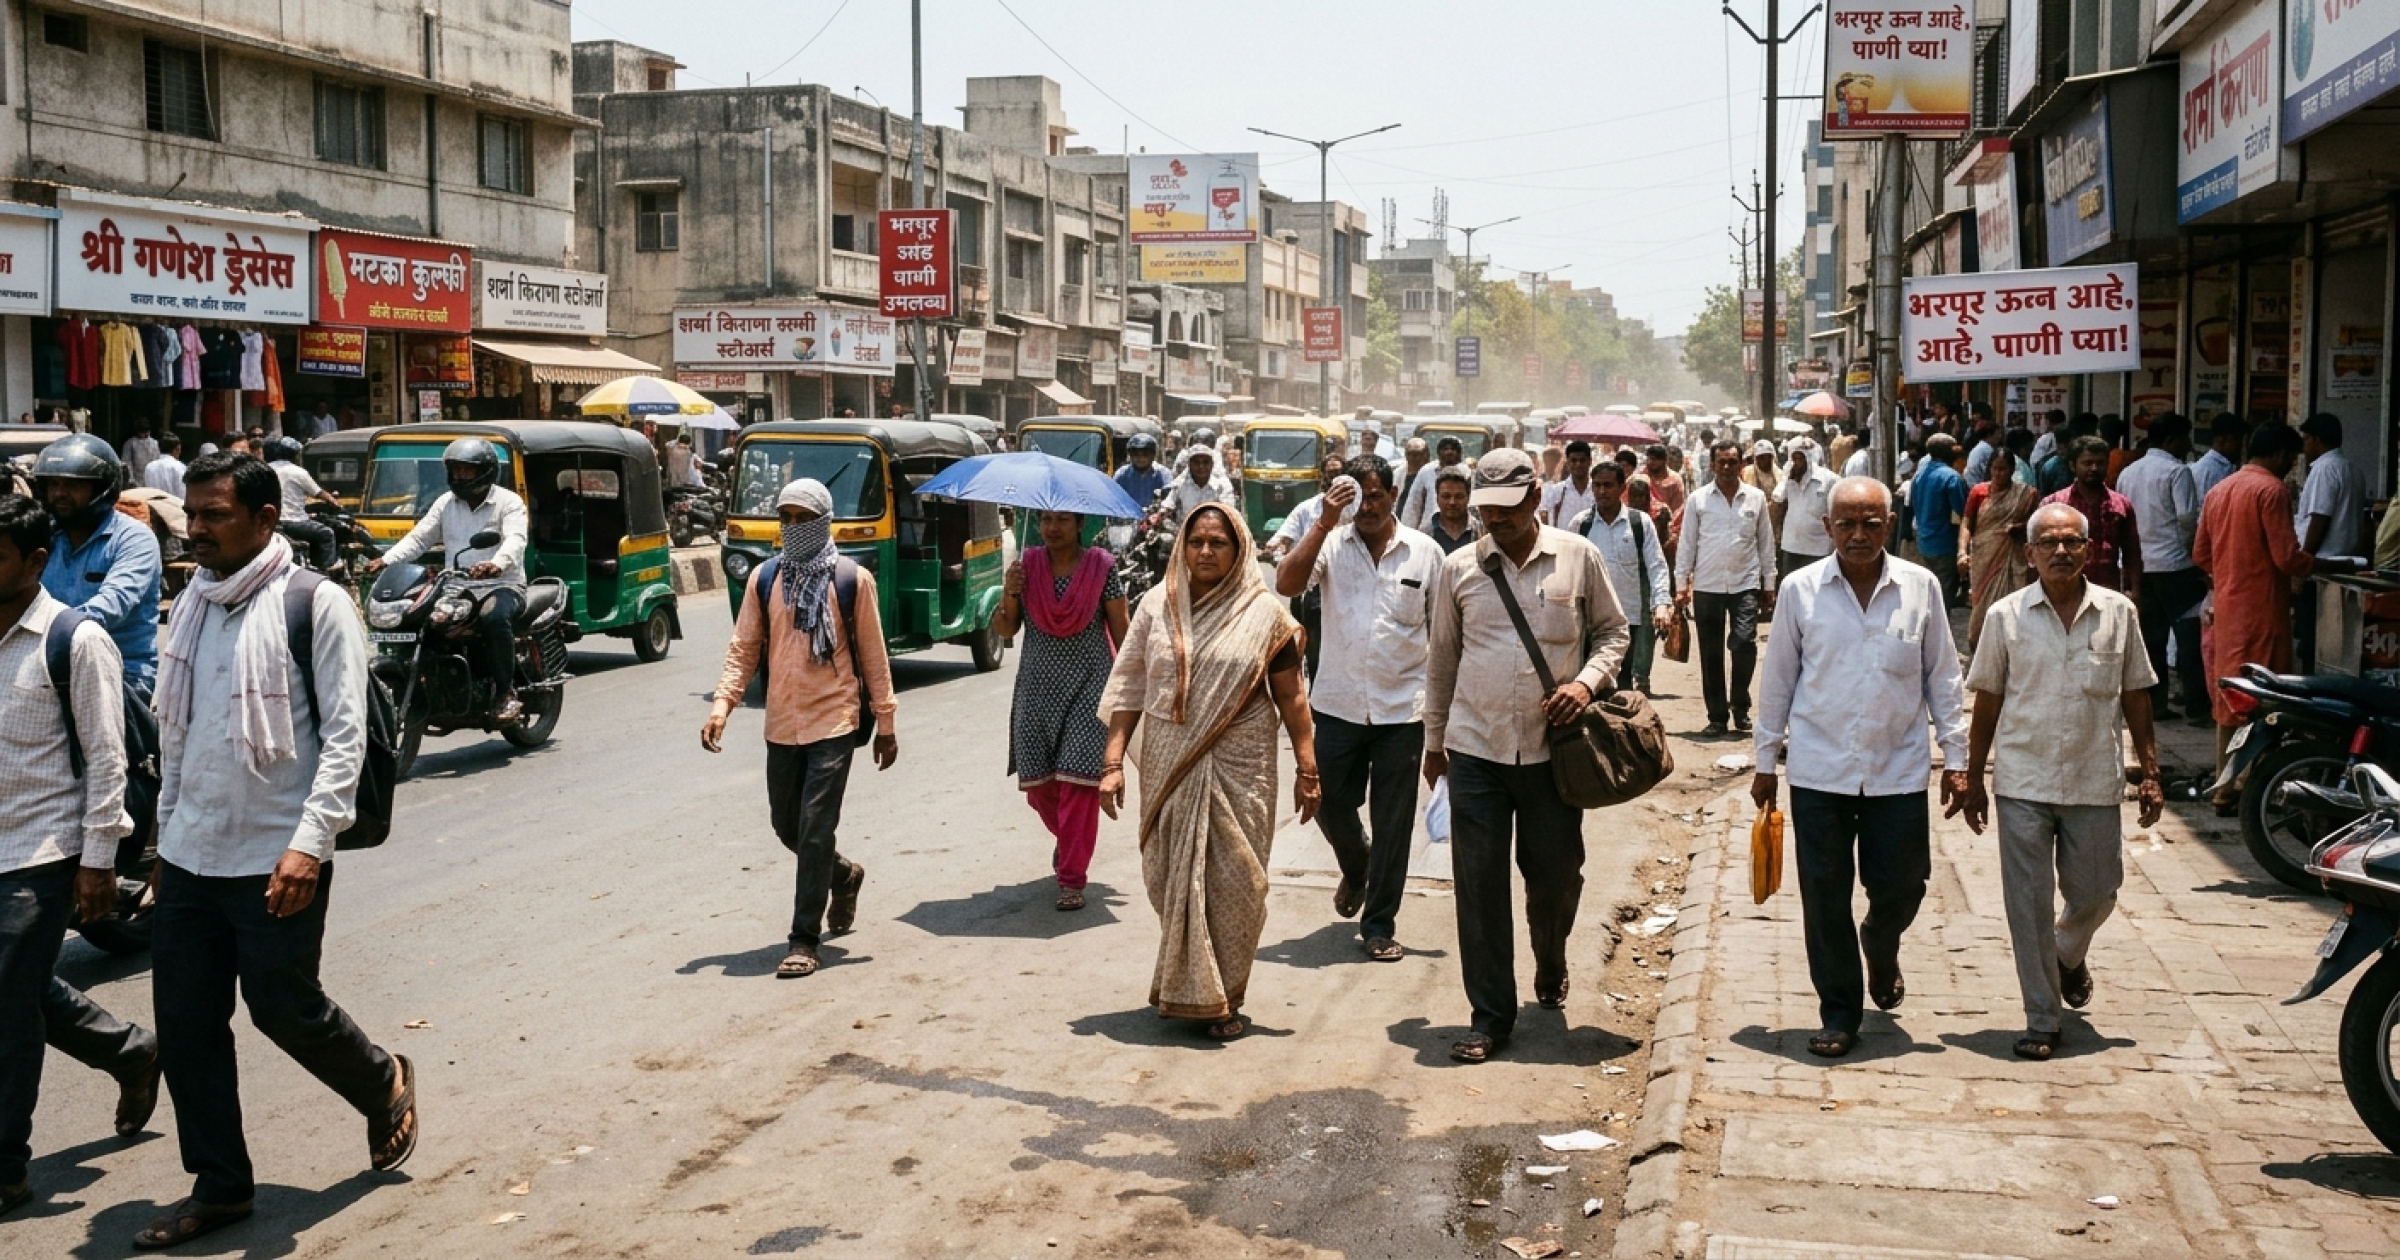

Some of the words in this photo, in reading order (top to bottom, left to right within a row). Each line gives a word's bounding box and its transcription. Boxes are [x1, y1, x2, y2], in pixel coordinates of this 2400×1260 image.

[1834, 11, 1884, 34] भरपूर
[1852, 34, 1901, 59] पाणी
[81, 218, 124, 274] श्री
[133, 225, 216, 283] गणेश
[223, 232, 295, 296] ड्रेसेस
[348, 252, 406, 287] मटका
[411, 253, 466, 302] कुल्फी
[1908, 291, 1986, 325] भरपूर
[1918, 327, 1983, 365] आहे,
[1992, 322, 2063, 358] पाणी
